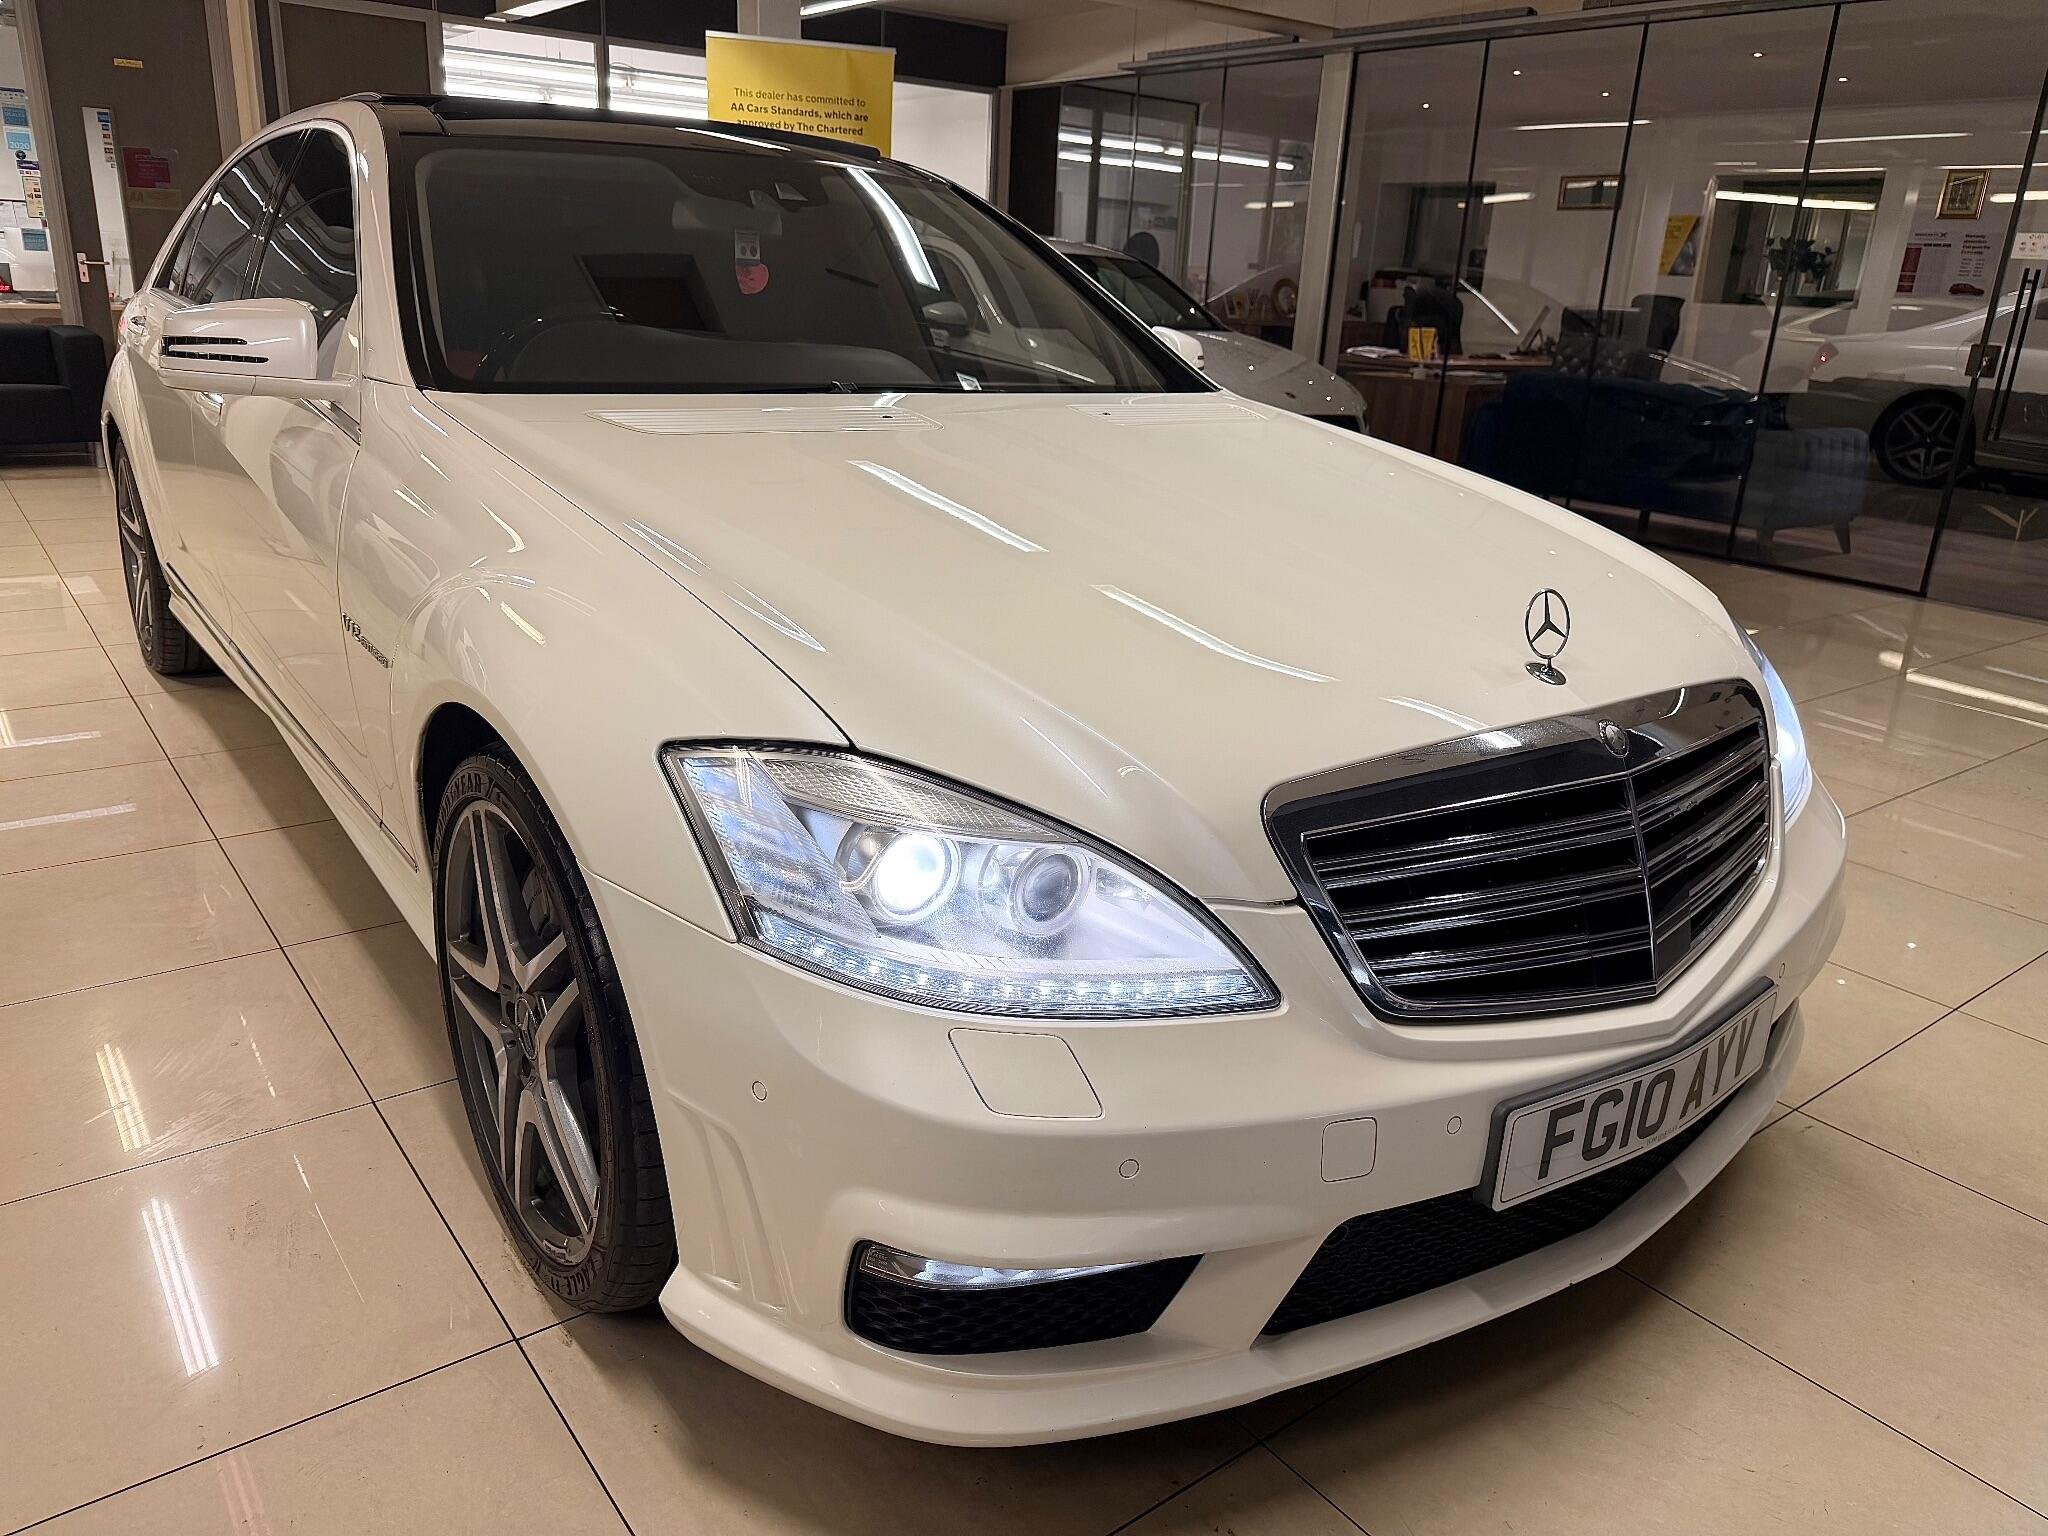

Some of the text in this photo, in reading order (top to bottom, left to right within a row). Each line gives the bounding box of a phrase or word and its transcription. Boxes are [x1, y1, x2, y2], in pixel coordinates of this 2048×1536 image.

[734, 87, 866, 107] This dealer has committed to
[730, 102, 869, 122] AA Cars Standards, which are
[783, 121, 795, 132] by
[796, 122, 814, 131] The
[816, 124, 864, 136] Chartered
[1537, 1008, 1760, 1181] FG10 AYV
